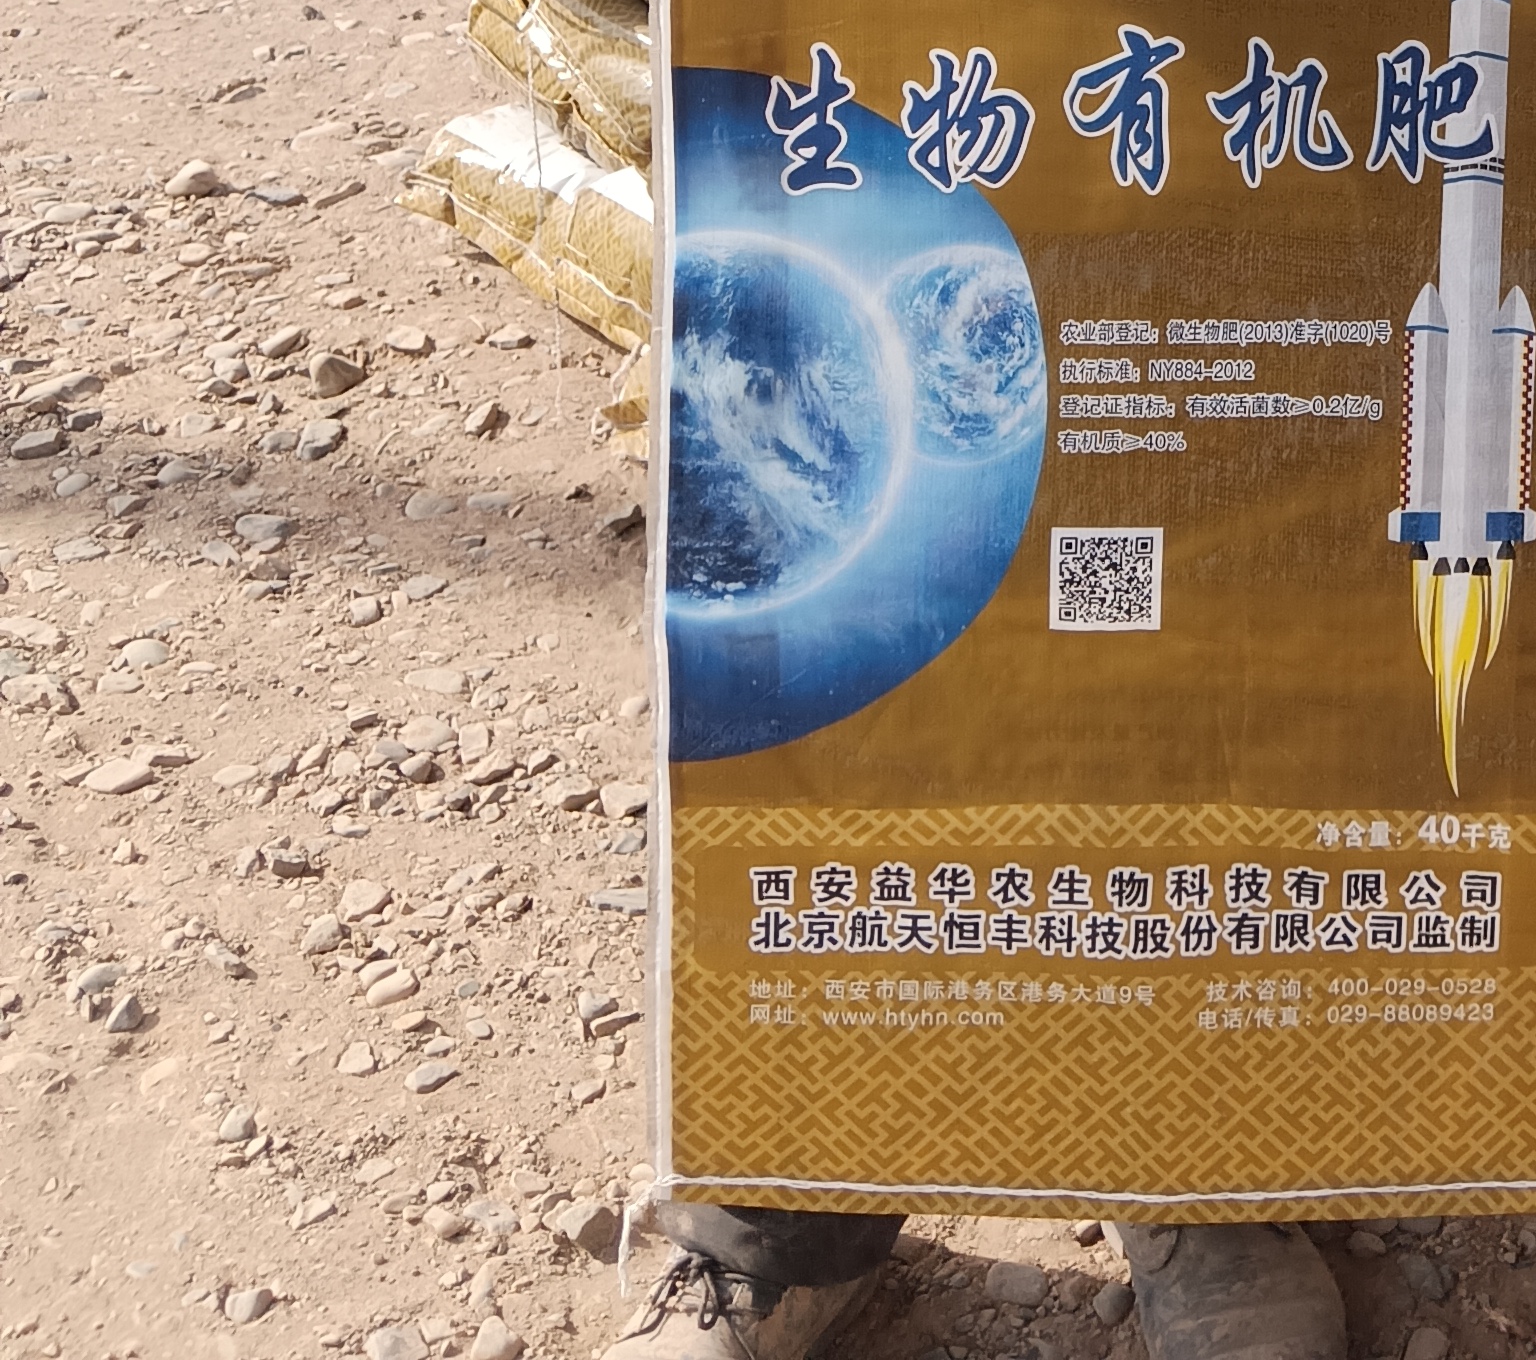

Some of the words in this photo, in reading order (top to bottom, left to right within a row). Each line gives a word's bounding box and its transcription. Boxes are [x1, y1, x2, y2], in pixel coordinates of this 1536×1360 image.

[765, 23, 1506, 194] 生物有机肥
[1058, 429, 1187, 453] 有机质≥40%
[749, 860, 1503, 912] 西安益华农生物科技有限公司
[749, 909, 1502, 958] 北京航天恒丰科技股份有限公司监制
